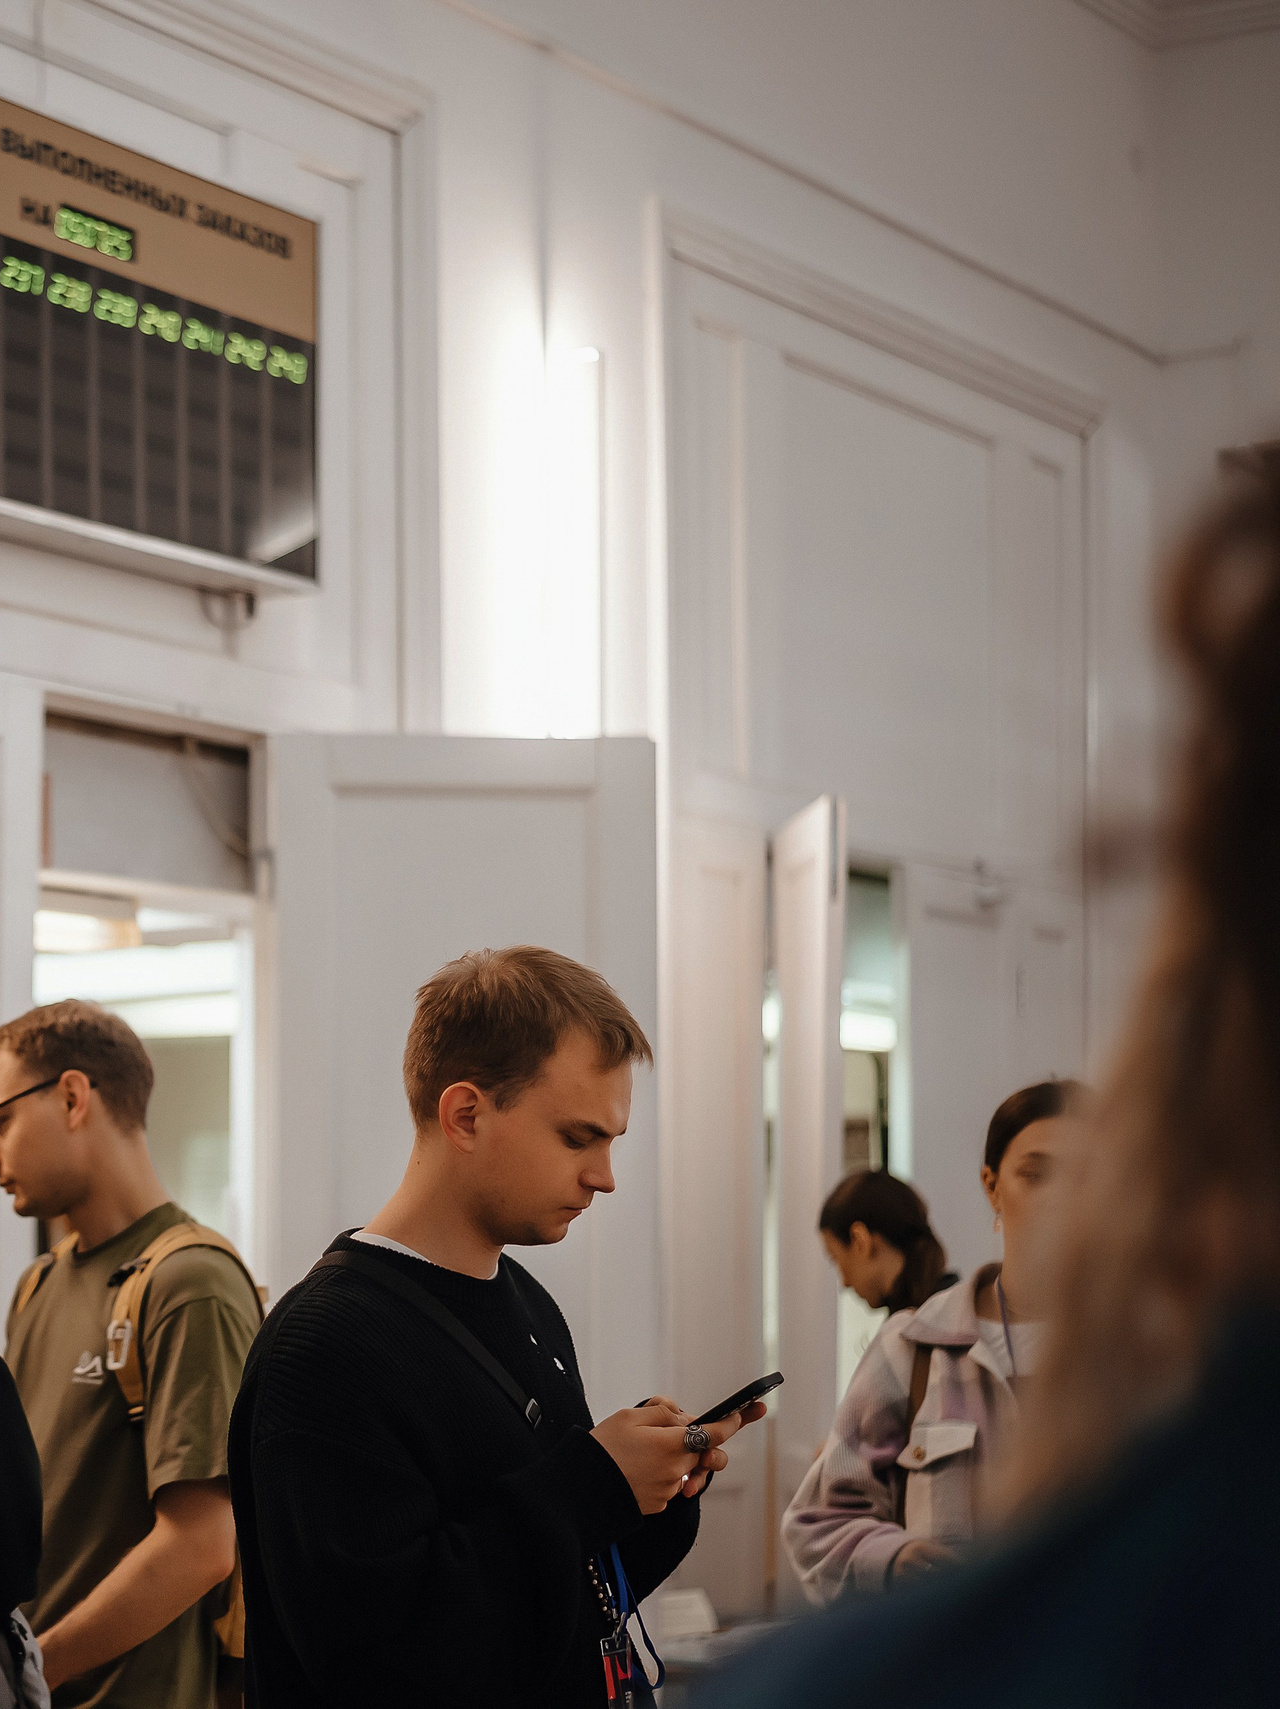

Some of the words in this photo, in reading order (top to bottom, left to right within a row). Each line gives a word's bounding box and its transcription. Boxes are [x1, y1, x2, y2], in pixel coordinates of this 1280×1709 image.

[0, 127, 187, 218] ВЫПОЛНЕННЫХ
[195, 204, 290, 258] ЗАКАЗОВ
[0, 256, 45, 296] 237
